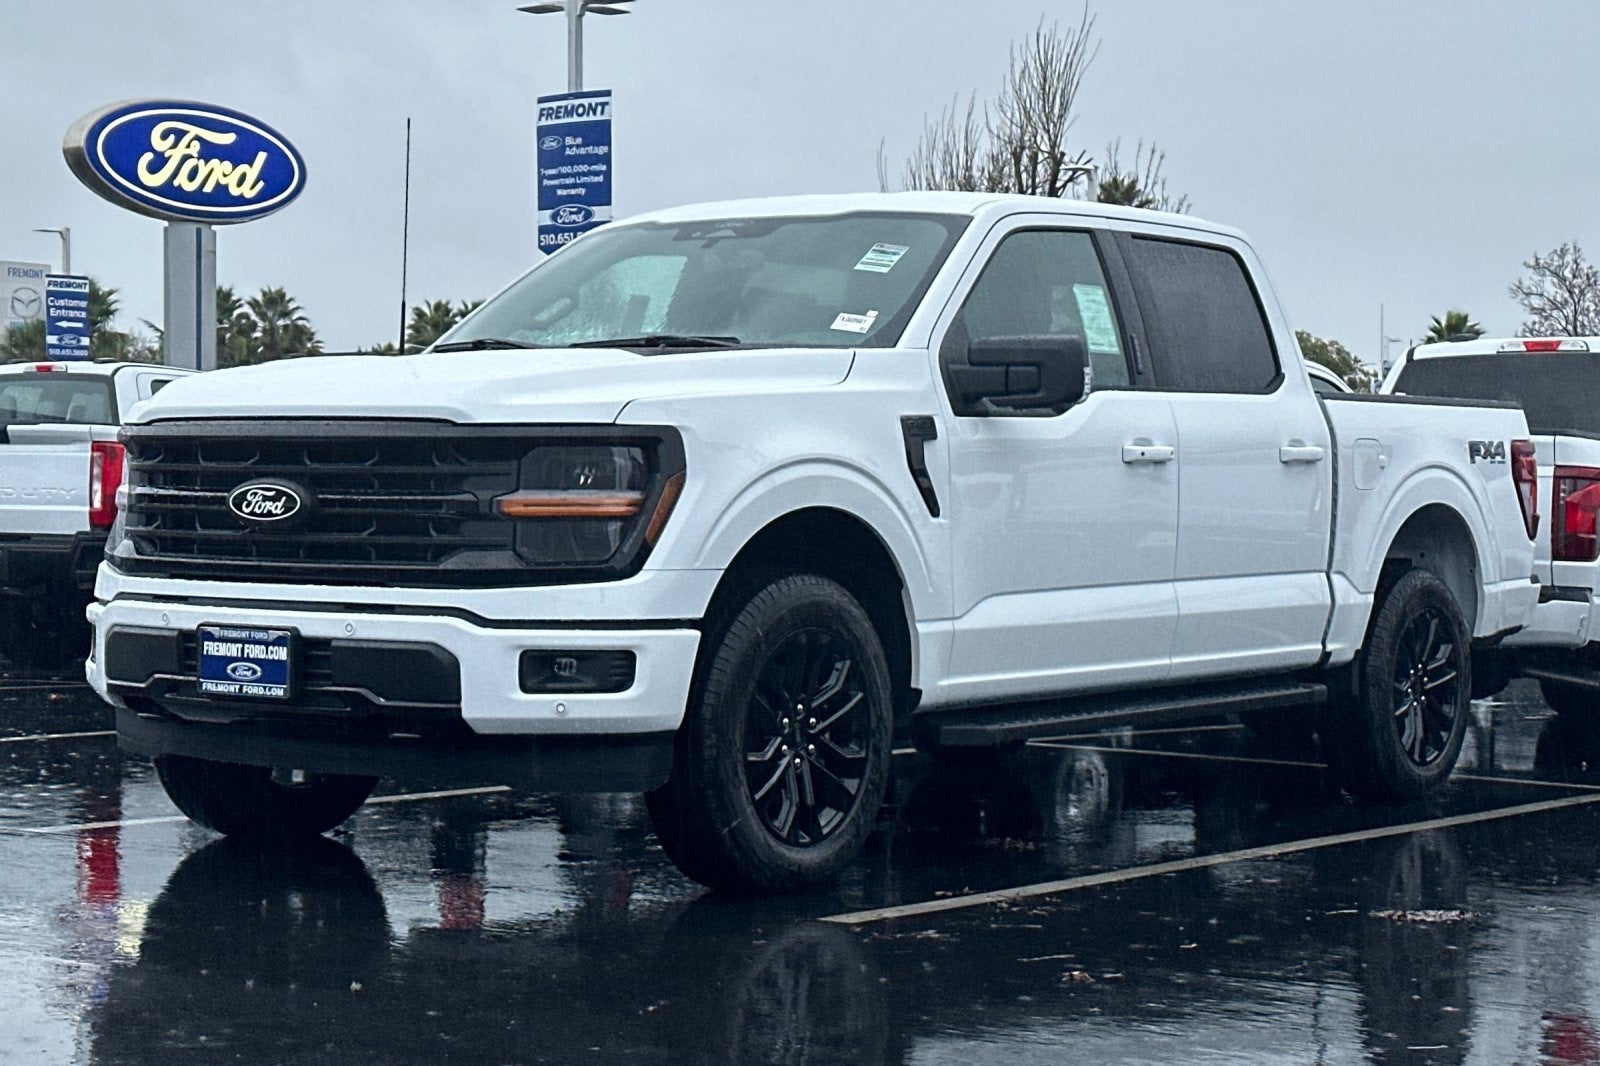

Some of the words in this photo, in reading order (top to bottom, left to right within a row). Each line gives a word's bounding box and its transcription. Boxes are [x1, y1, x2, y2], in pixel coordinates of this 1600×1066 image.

[538, 101, 609, 121] FREMONT
[565, 136, 583, 145] Blue
[565, 145, 609, 155] Advantage
[137, 121, 268, 198] Ford
[576, 175, 604, 183] Limited
[556, 188, 587, 196] Warranty
[557, 207, 585, 223] Ford
[7, 267, 44, 279] FREMONT
[47, 280, 88, 290] FREMONT
[48, 297, 88, 308] Customer
[49, 308, 87, 318] Entrance
[1468, 440, 1506, 464] FX4
[242, 489, 286, 514] Ford
[220, 629, 250, 639] FREMONT
[251, 630, 268, 640] FORD
[203, 641, 242, 657] FREMONT
[243, 643, 287, 660] FORD.COM
[235, 666, 253, 677] Ford
[202, 683, 240, 693] FREMONT
[242, 685, 284, 696] FORD.COM
